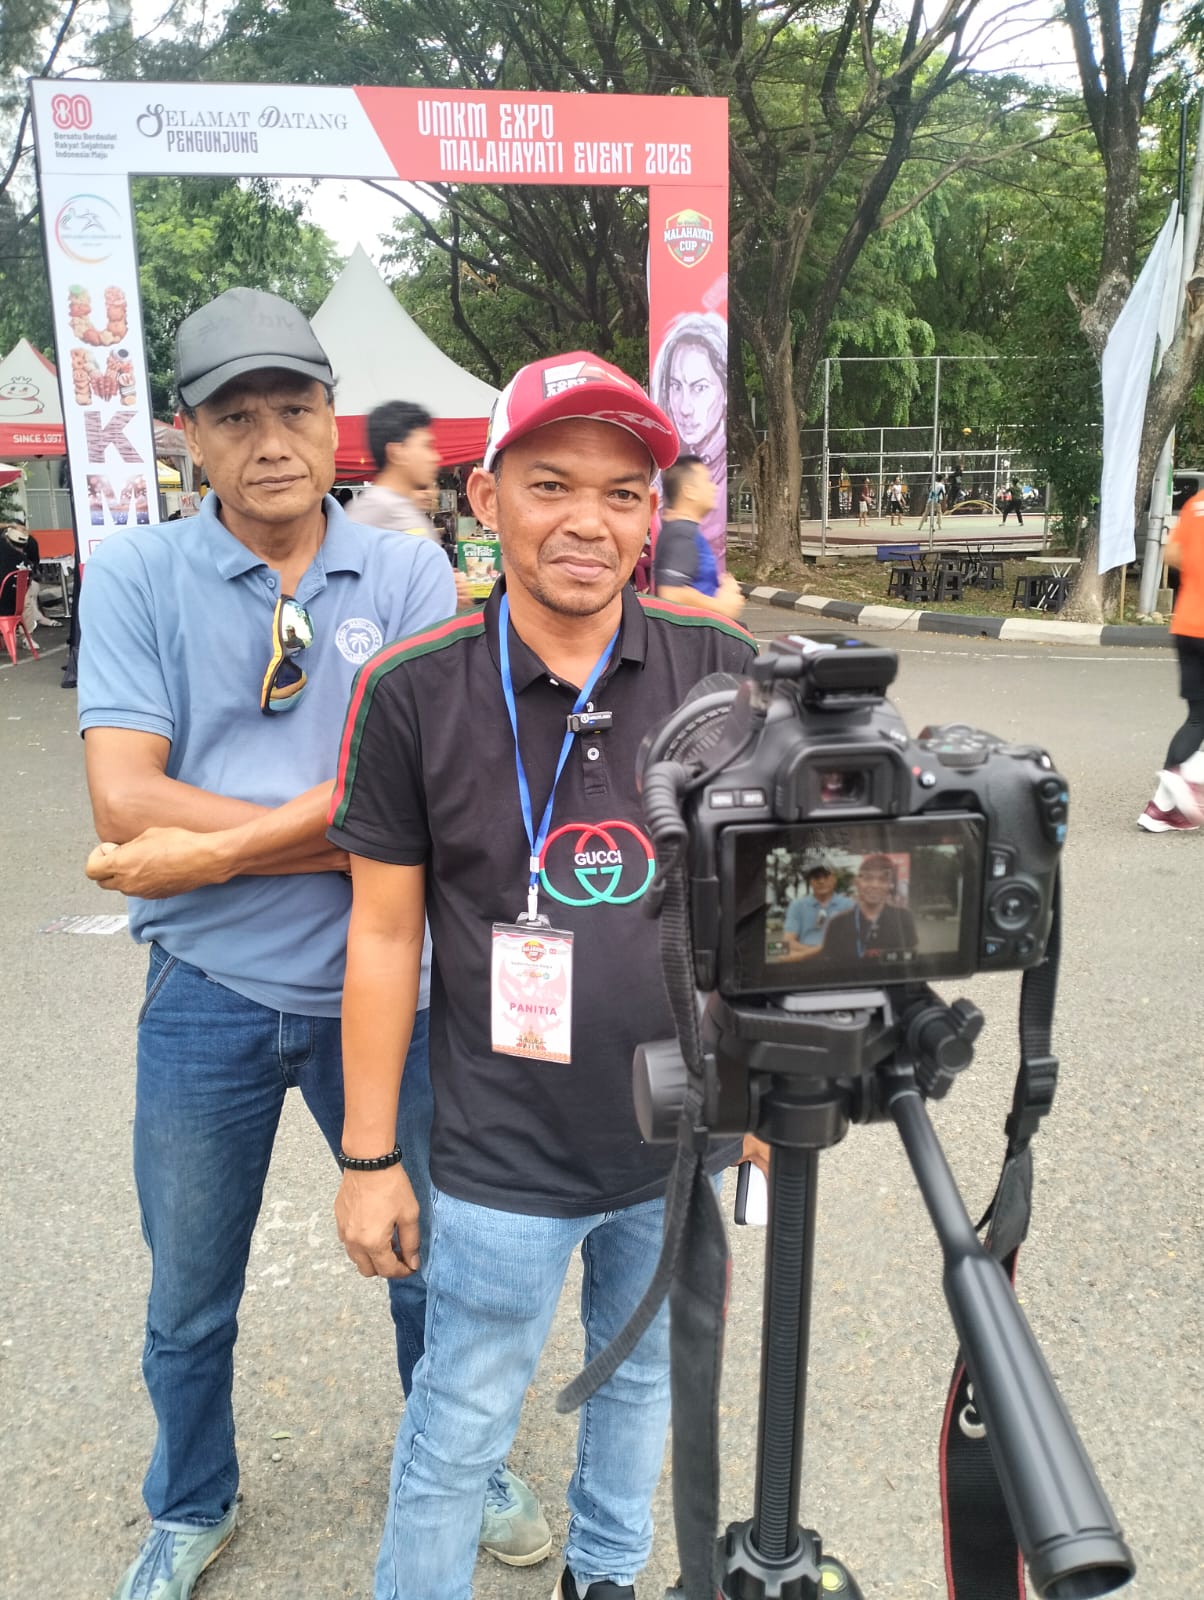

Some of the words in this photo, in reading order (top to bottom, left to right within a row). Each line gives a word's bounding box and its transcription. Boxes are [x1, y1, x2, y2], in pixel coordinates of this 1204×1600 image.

[51, 94, 92, 130] 80
[417, 100, 487, 138] UMKM
[499, 103, 554, 139] EXPO
[167, 130, 259, 153] PENGUNJUNG
[440, 139, 563, 173] MALAHAYATI
[574, 142, 634, 174] EVENT
[645, 144, 692, 175] 2025
[663, 227, 713, 243] MALAHAYATI
[679, 240, 697, 252] CUP
[12, 434, 41, 444] SINCE
[574, 850, 622, 865] GUCCI
[510, 1002, 557, 1016] PANITIA
